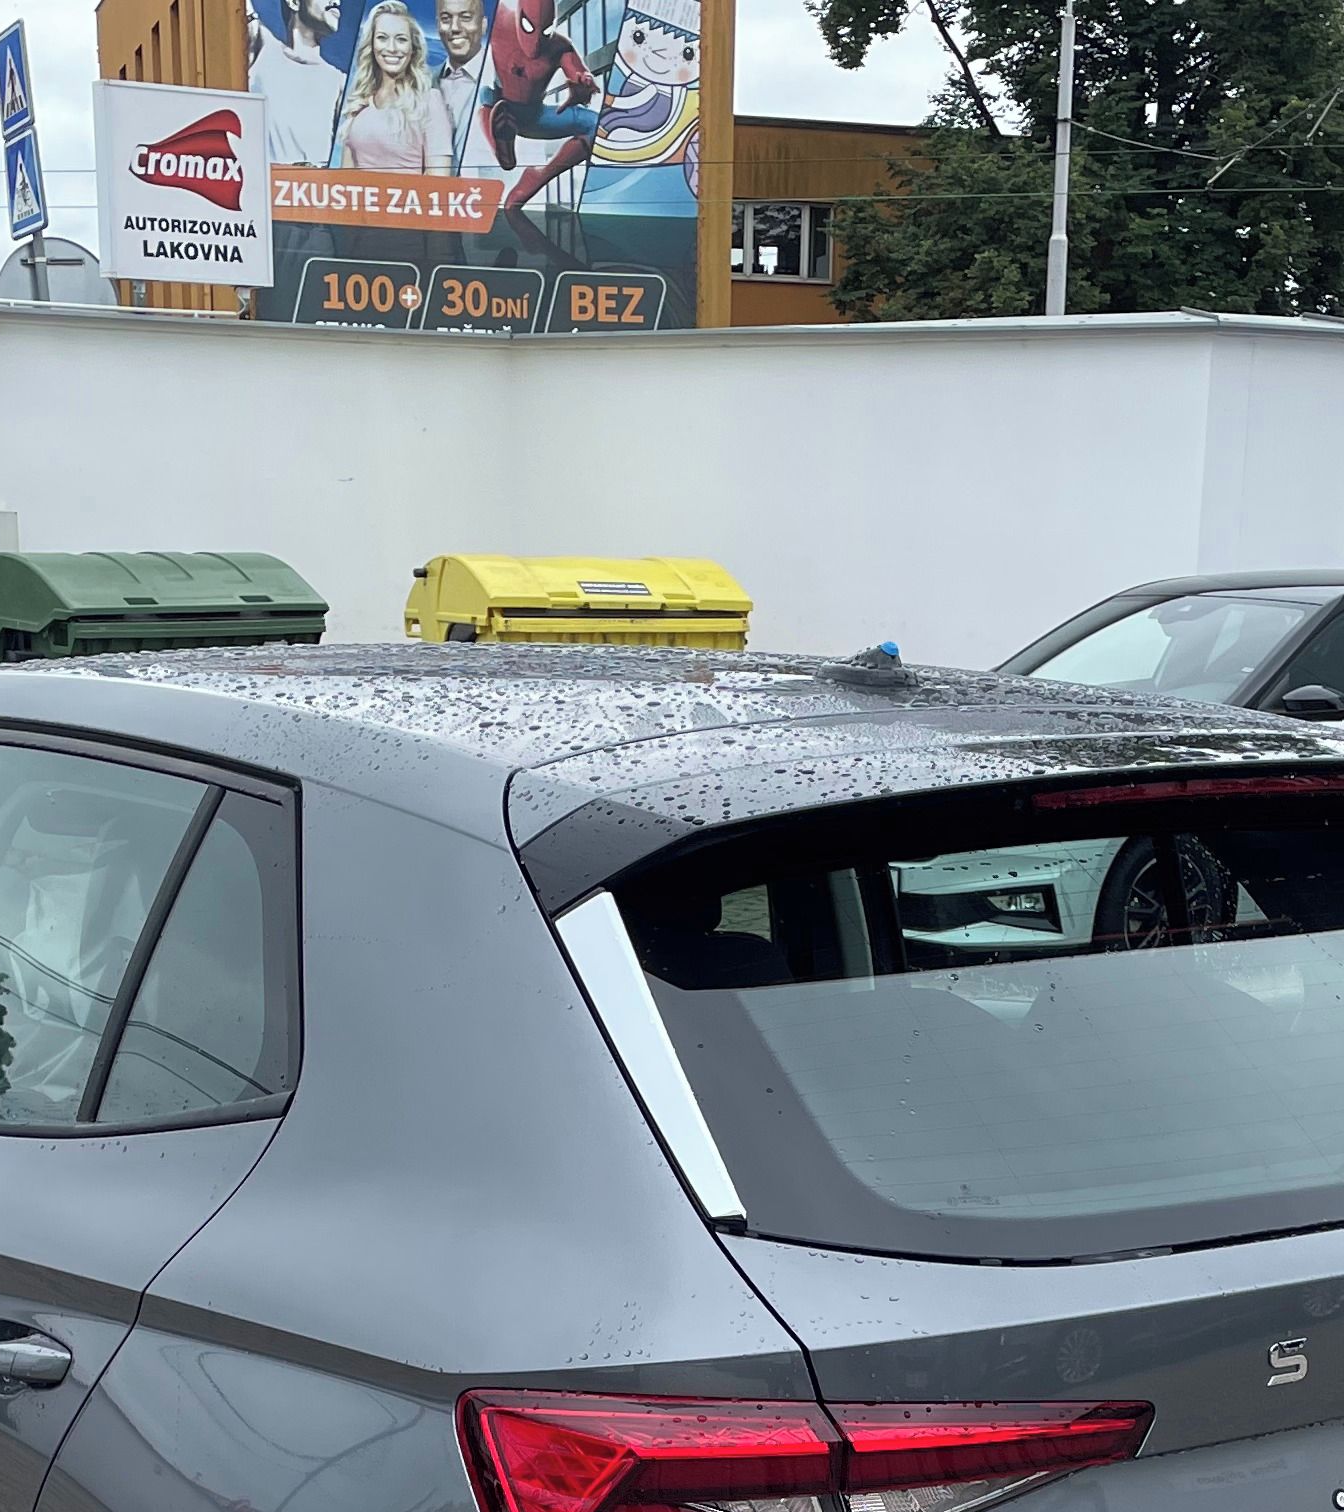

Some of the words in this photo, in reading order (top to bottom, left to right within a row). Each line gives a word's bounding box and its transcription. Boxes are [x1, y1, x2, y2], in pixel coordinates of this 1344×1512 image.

[130, 146, 242, 182] Cromax
[274, 180, 380, 212] ZKUSTE
[386, 188, 423, 216] ZA
[427, 191, 443, 217] 1
[447, 187, 484, 219] KČ
[124, 215, 257, 239] AUTORIZOVANÁ
[143, 240, 243, 263] LAKOVNA
[441, 279, 489, 318] 30
[491, 292, 529, 319] DNÍ
[570, 284, 645, 324] BEZ
